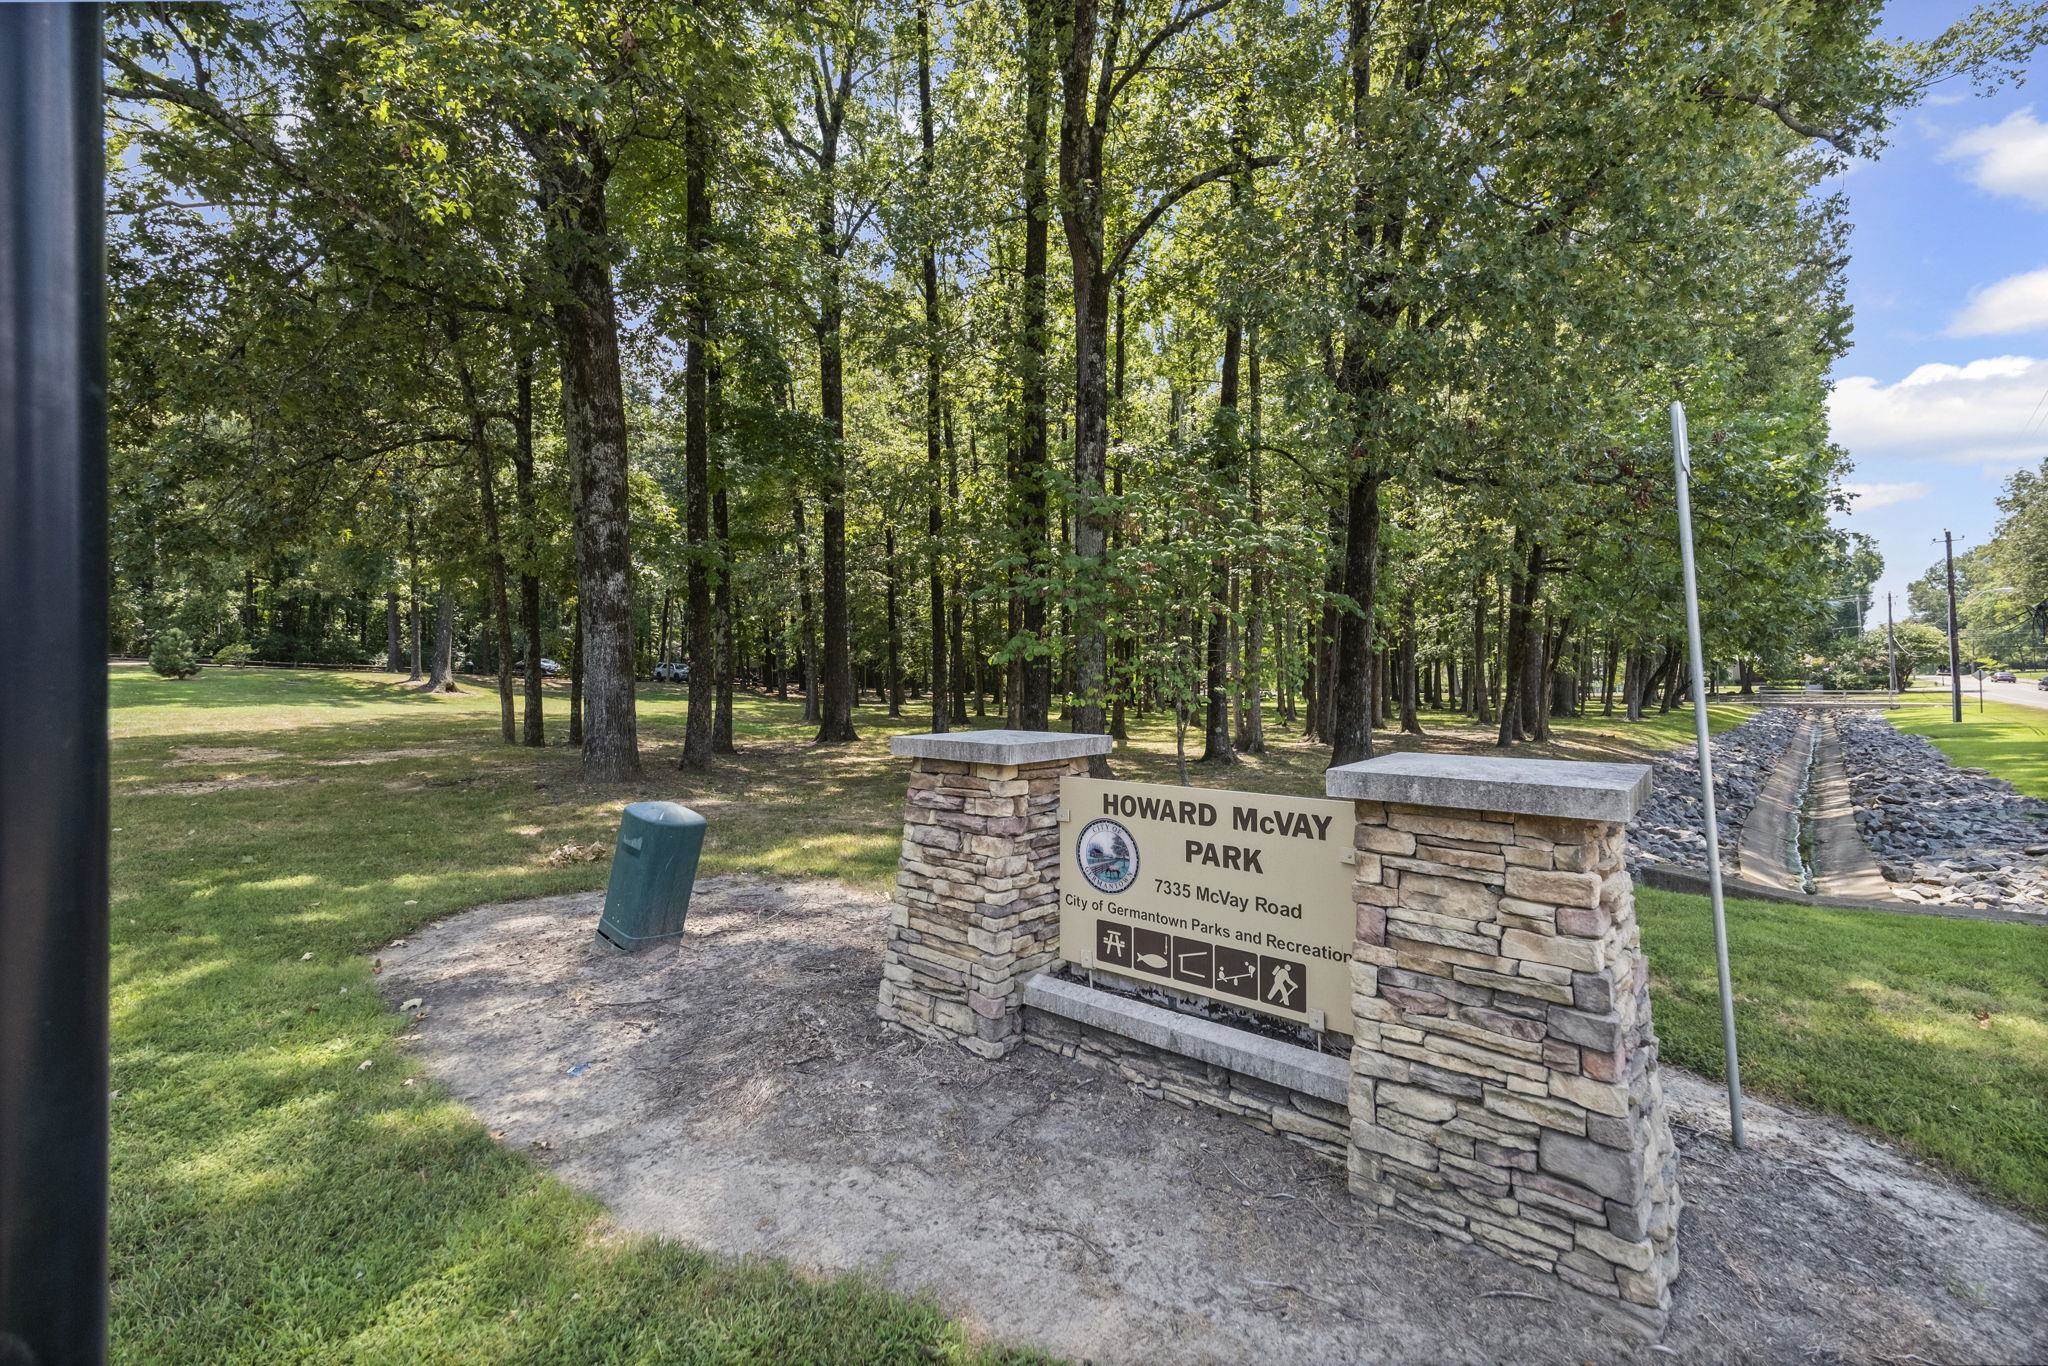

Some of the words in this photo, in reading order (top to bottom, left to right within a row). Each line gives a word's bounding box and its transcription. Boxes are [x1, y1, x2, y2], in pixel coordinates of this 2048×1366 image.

[1103, 793, 1217, 827] HOWARD
[1232, 806, 1333, 841] McVAY
[1185, 840, 1263, 874] PARK
[1154, 879, 1191, 899] 7335
[1196, 886, 1248, 913] McVay
[1255, 897, 1302, 920] Road
[1065, 893, 1088, 911] City
[1091, 900, 1104, 913] of
[1107, 902, 1187, 930] Germantown
[1191, 918, 1230, 939] Parks
[1235, 929, 1262, 947] and
[1266, 935, 1352, 963] Recreation
